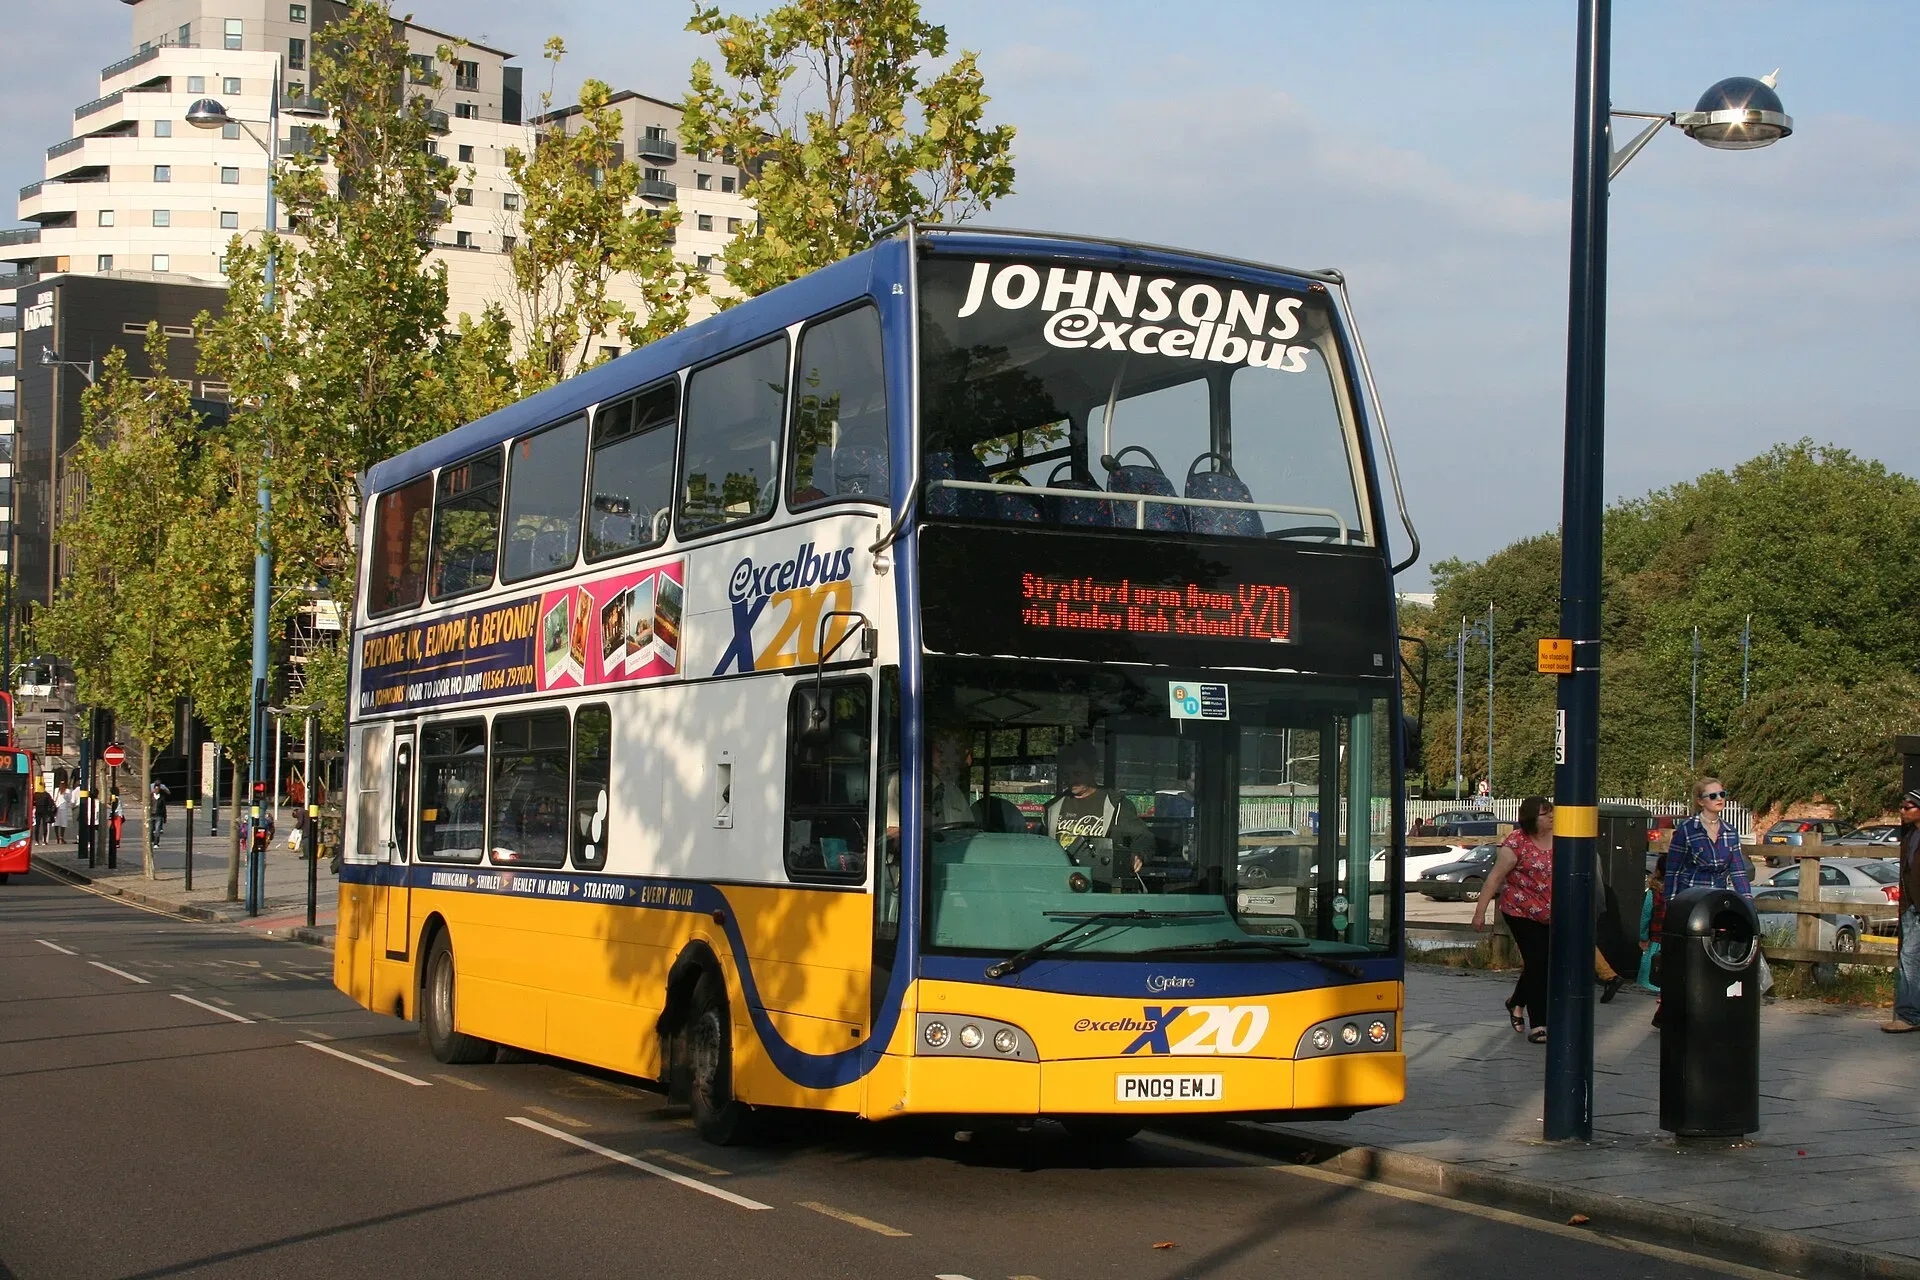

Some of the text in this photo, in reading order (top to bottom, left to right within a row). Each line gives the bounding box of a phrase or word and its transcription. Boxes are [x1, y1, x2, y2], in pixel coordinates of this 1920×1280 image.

[957, 262, 1303, 340] JOHNSONS
[1022, 573, 1290, 638] Stratford upon Avon X20
[1022, 602, 1236, 636] via Henley High School
[363, 631, 405, 669] EXPLORE
[425, 618, 466, 657] EUROPE
[469, 616, 480, 649] &
[481, 601, 538, 647] BEYOND!
[712, 580, 853, 676] X20
[1549, 653, 1569, 661] stopping
[361, 691, 370, 709] ON
[369, 690, 375, 707] A
[423, 681, 433, 699] TO
[432, 678, 450, 698] DOOR
[482, 669, 505, 690] 01564
[431, 871, 694, 906] BIRMINGHAM SHIRLEY HENLEY IN ARDEN STRATFORD EVERY HOUR
[1154, 975, 1195, 991] Optare
[1120, 1005, 1270, 1054] X20
[1125, 1078, 1215, 1098] PN09 EMJ
